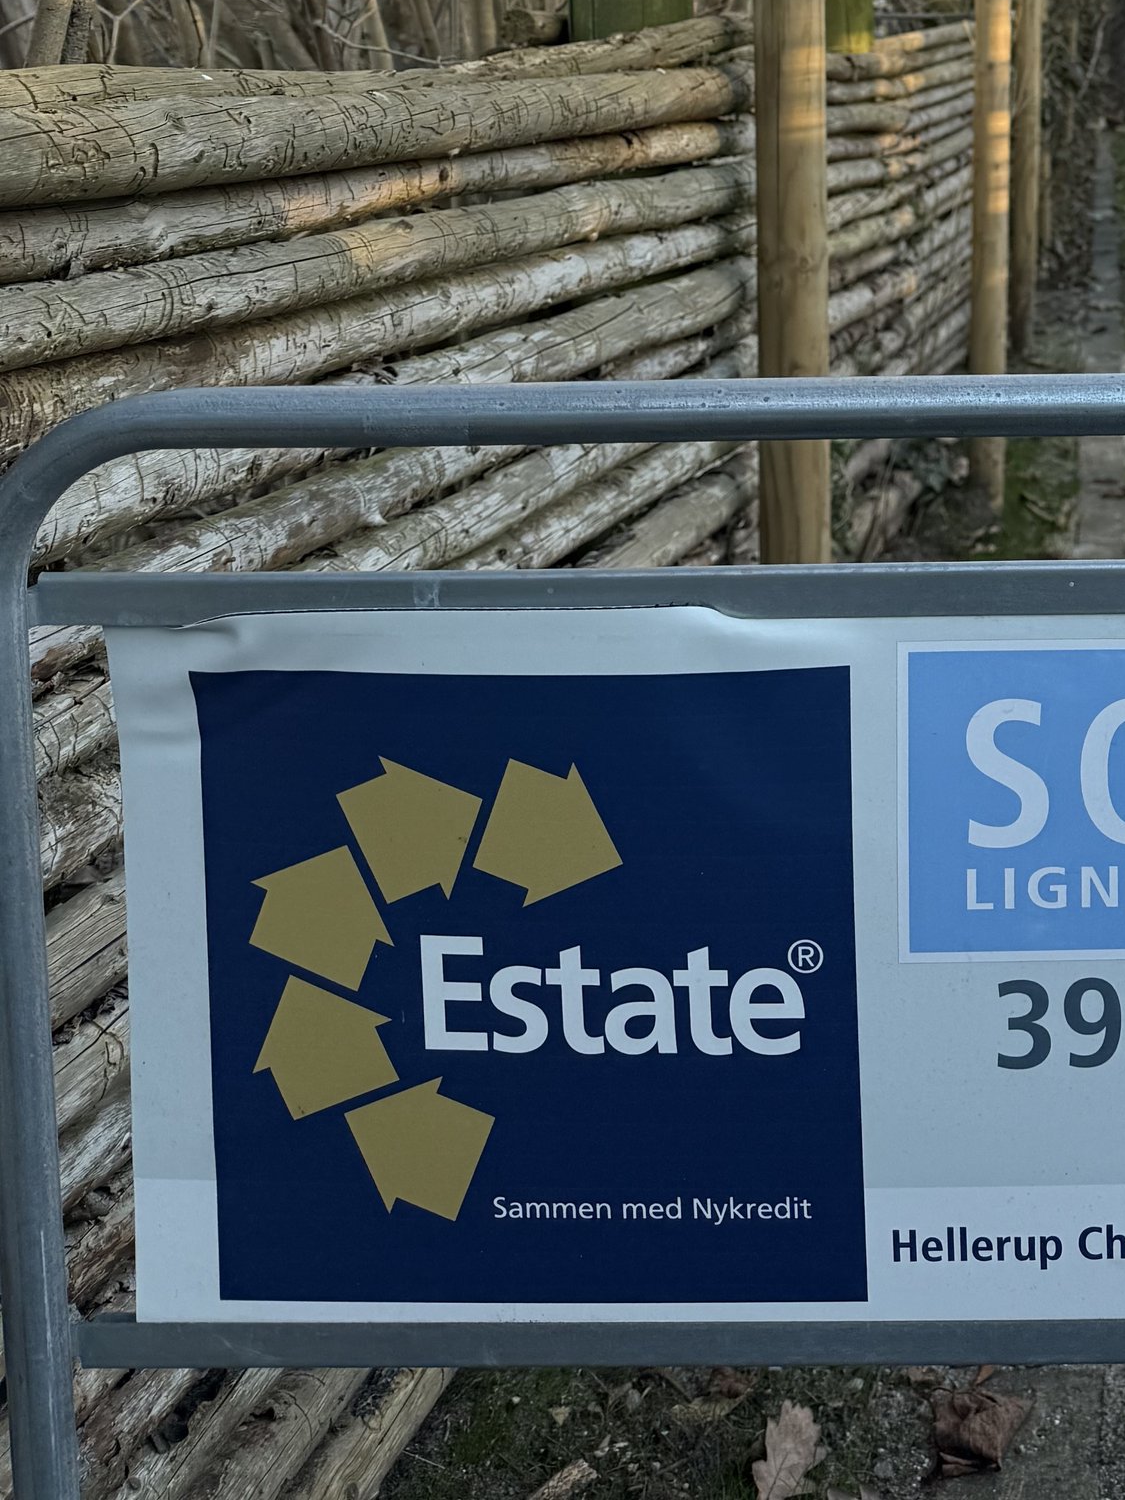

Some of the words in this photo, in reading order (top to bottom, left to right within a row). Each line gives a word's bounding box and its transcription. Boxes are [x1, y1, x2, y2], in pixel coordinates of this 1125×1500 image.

[492, 1196, 613, 1221] Sammen
[621, 1196, 684, 1220] med
[692, 1196, 812, 1225] Nykredit
[891, 1226, 1063, 1270] Hellerup
